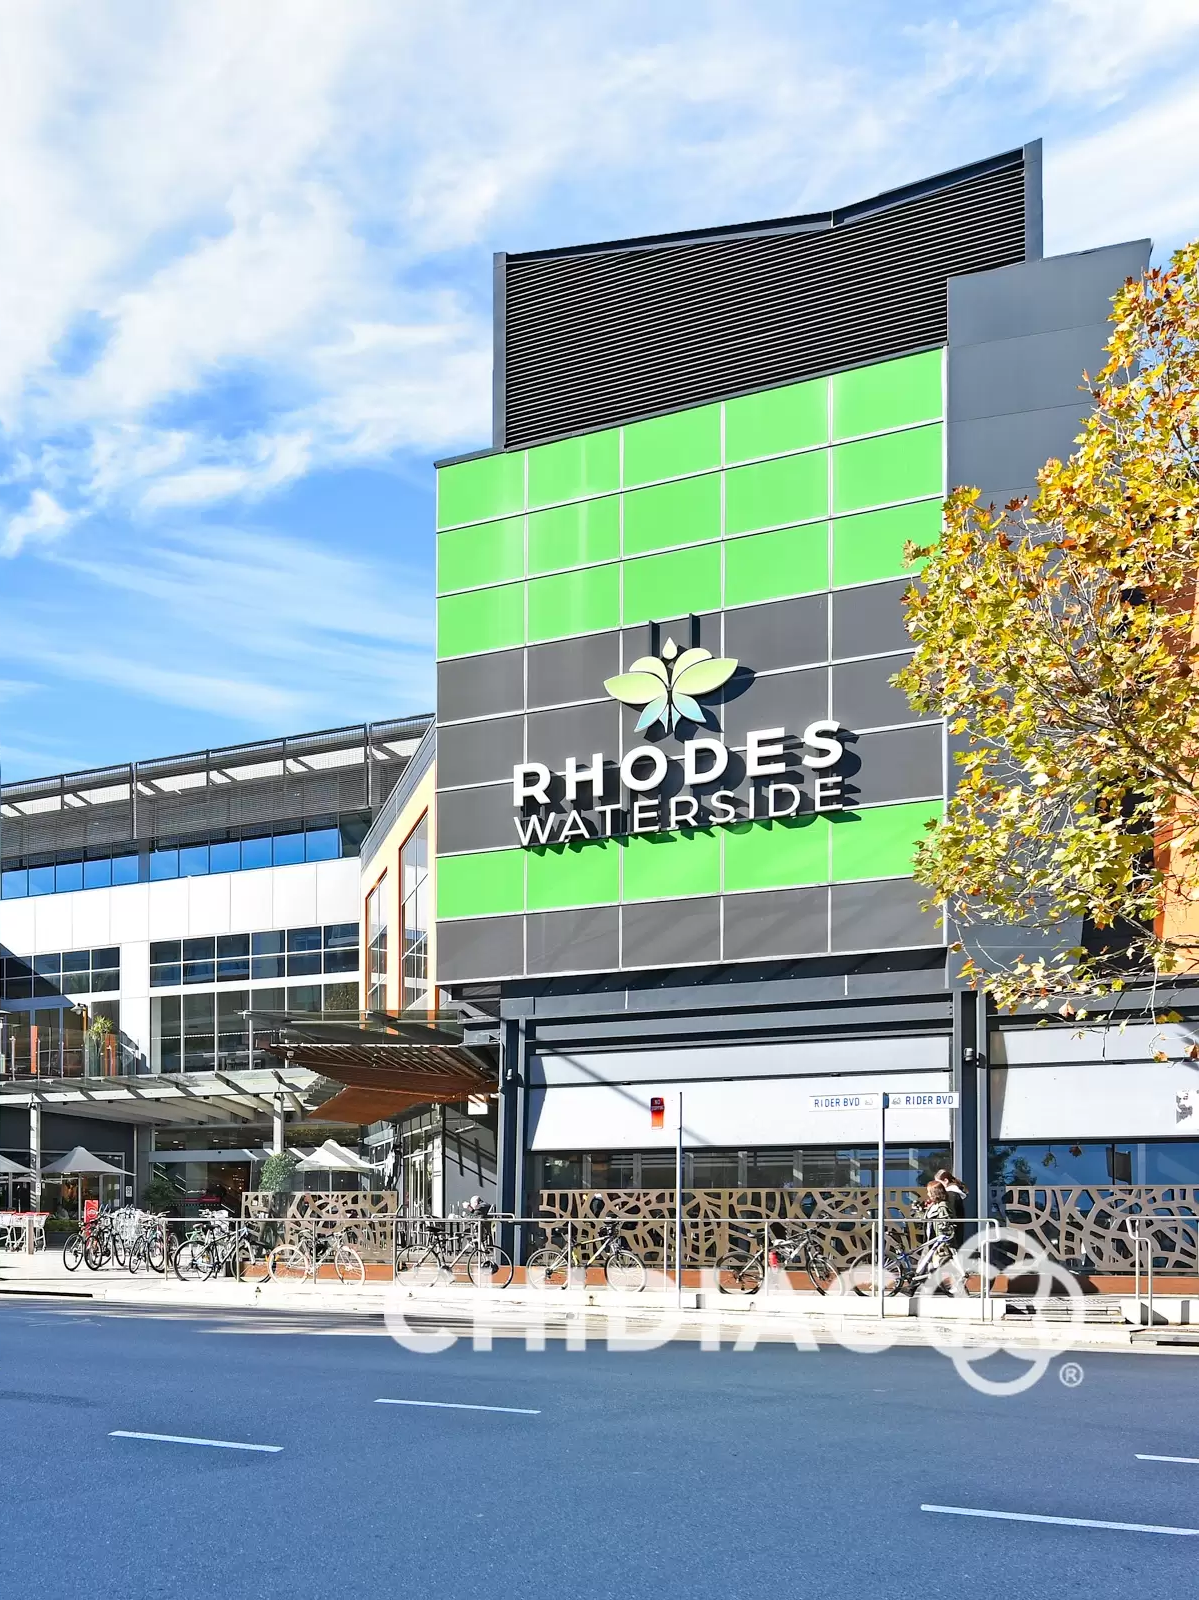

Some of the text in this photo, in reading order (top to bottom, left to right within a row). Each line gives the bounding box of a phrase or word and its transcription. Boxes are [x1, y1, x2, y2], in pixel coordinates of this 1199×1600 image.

[513, 719, 843, 807] RHODES
[513, 776, 843, 846] WATERSIDE
[814, 1097, 860, 1108] RIDER BVD
[905, 1095, 954, 1105] RIDER BVD
